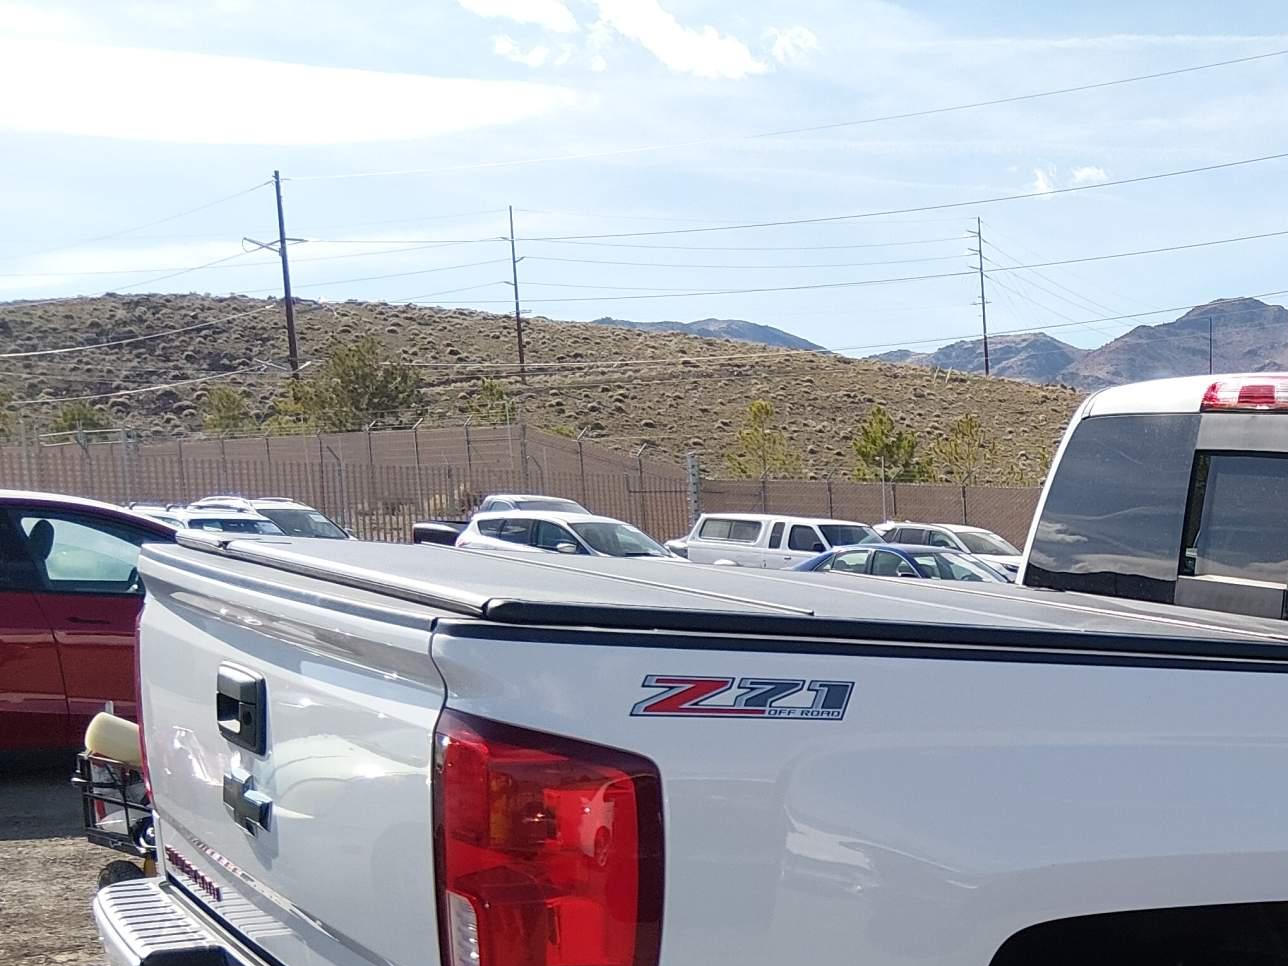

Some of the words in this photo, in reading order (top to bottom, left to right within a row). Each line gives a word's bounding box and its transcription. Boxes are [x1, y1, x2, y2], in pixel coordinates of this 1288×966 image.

[630, 674, 855, 720] Z71
[767, 708, 795, 717] OFF
[800, 709, 841, 718] ROAD
